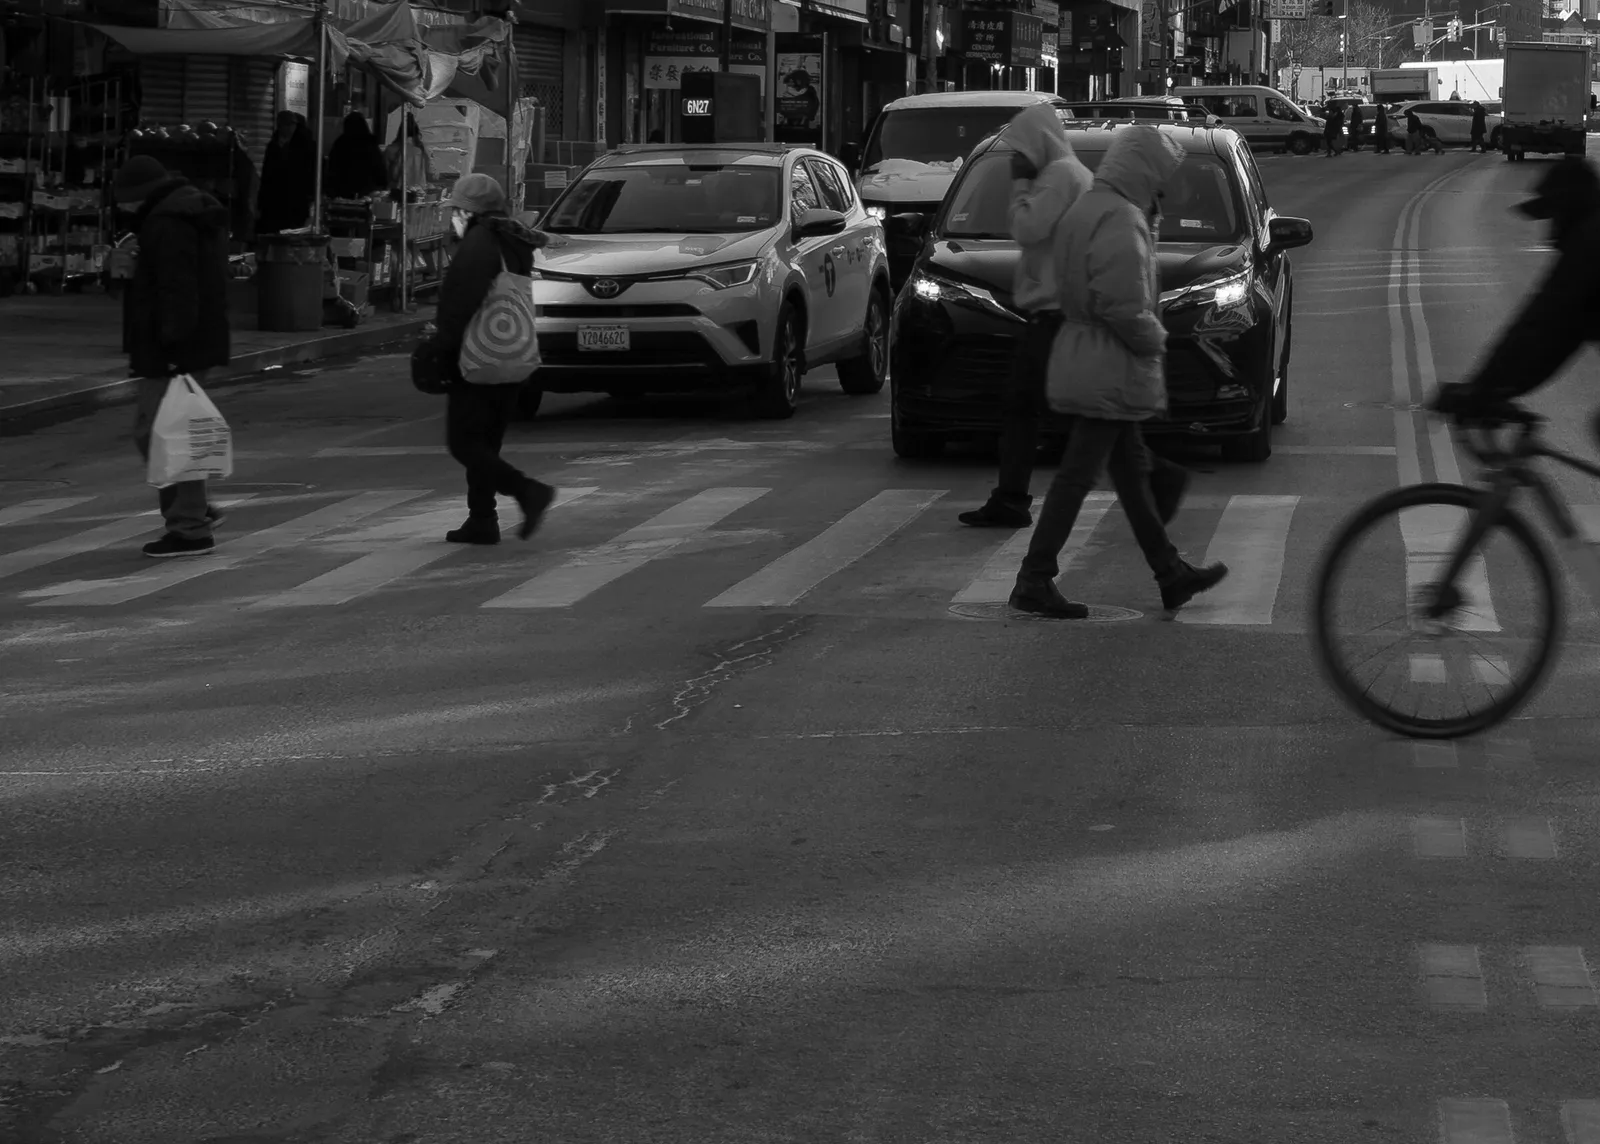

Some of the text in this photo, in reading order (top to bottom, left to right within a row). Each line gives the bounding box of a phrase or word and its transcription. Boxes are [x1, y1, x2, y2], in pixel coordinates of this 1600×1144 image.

[651, 30, 714, 42] International
[650, 43, 715, 54] Furniture Co.
[747, 52, 763, 62] Co.
[686, 99, 710, 115] 6N27
